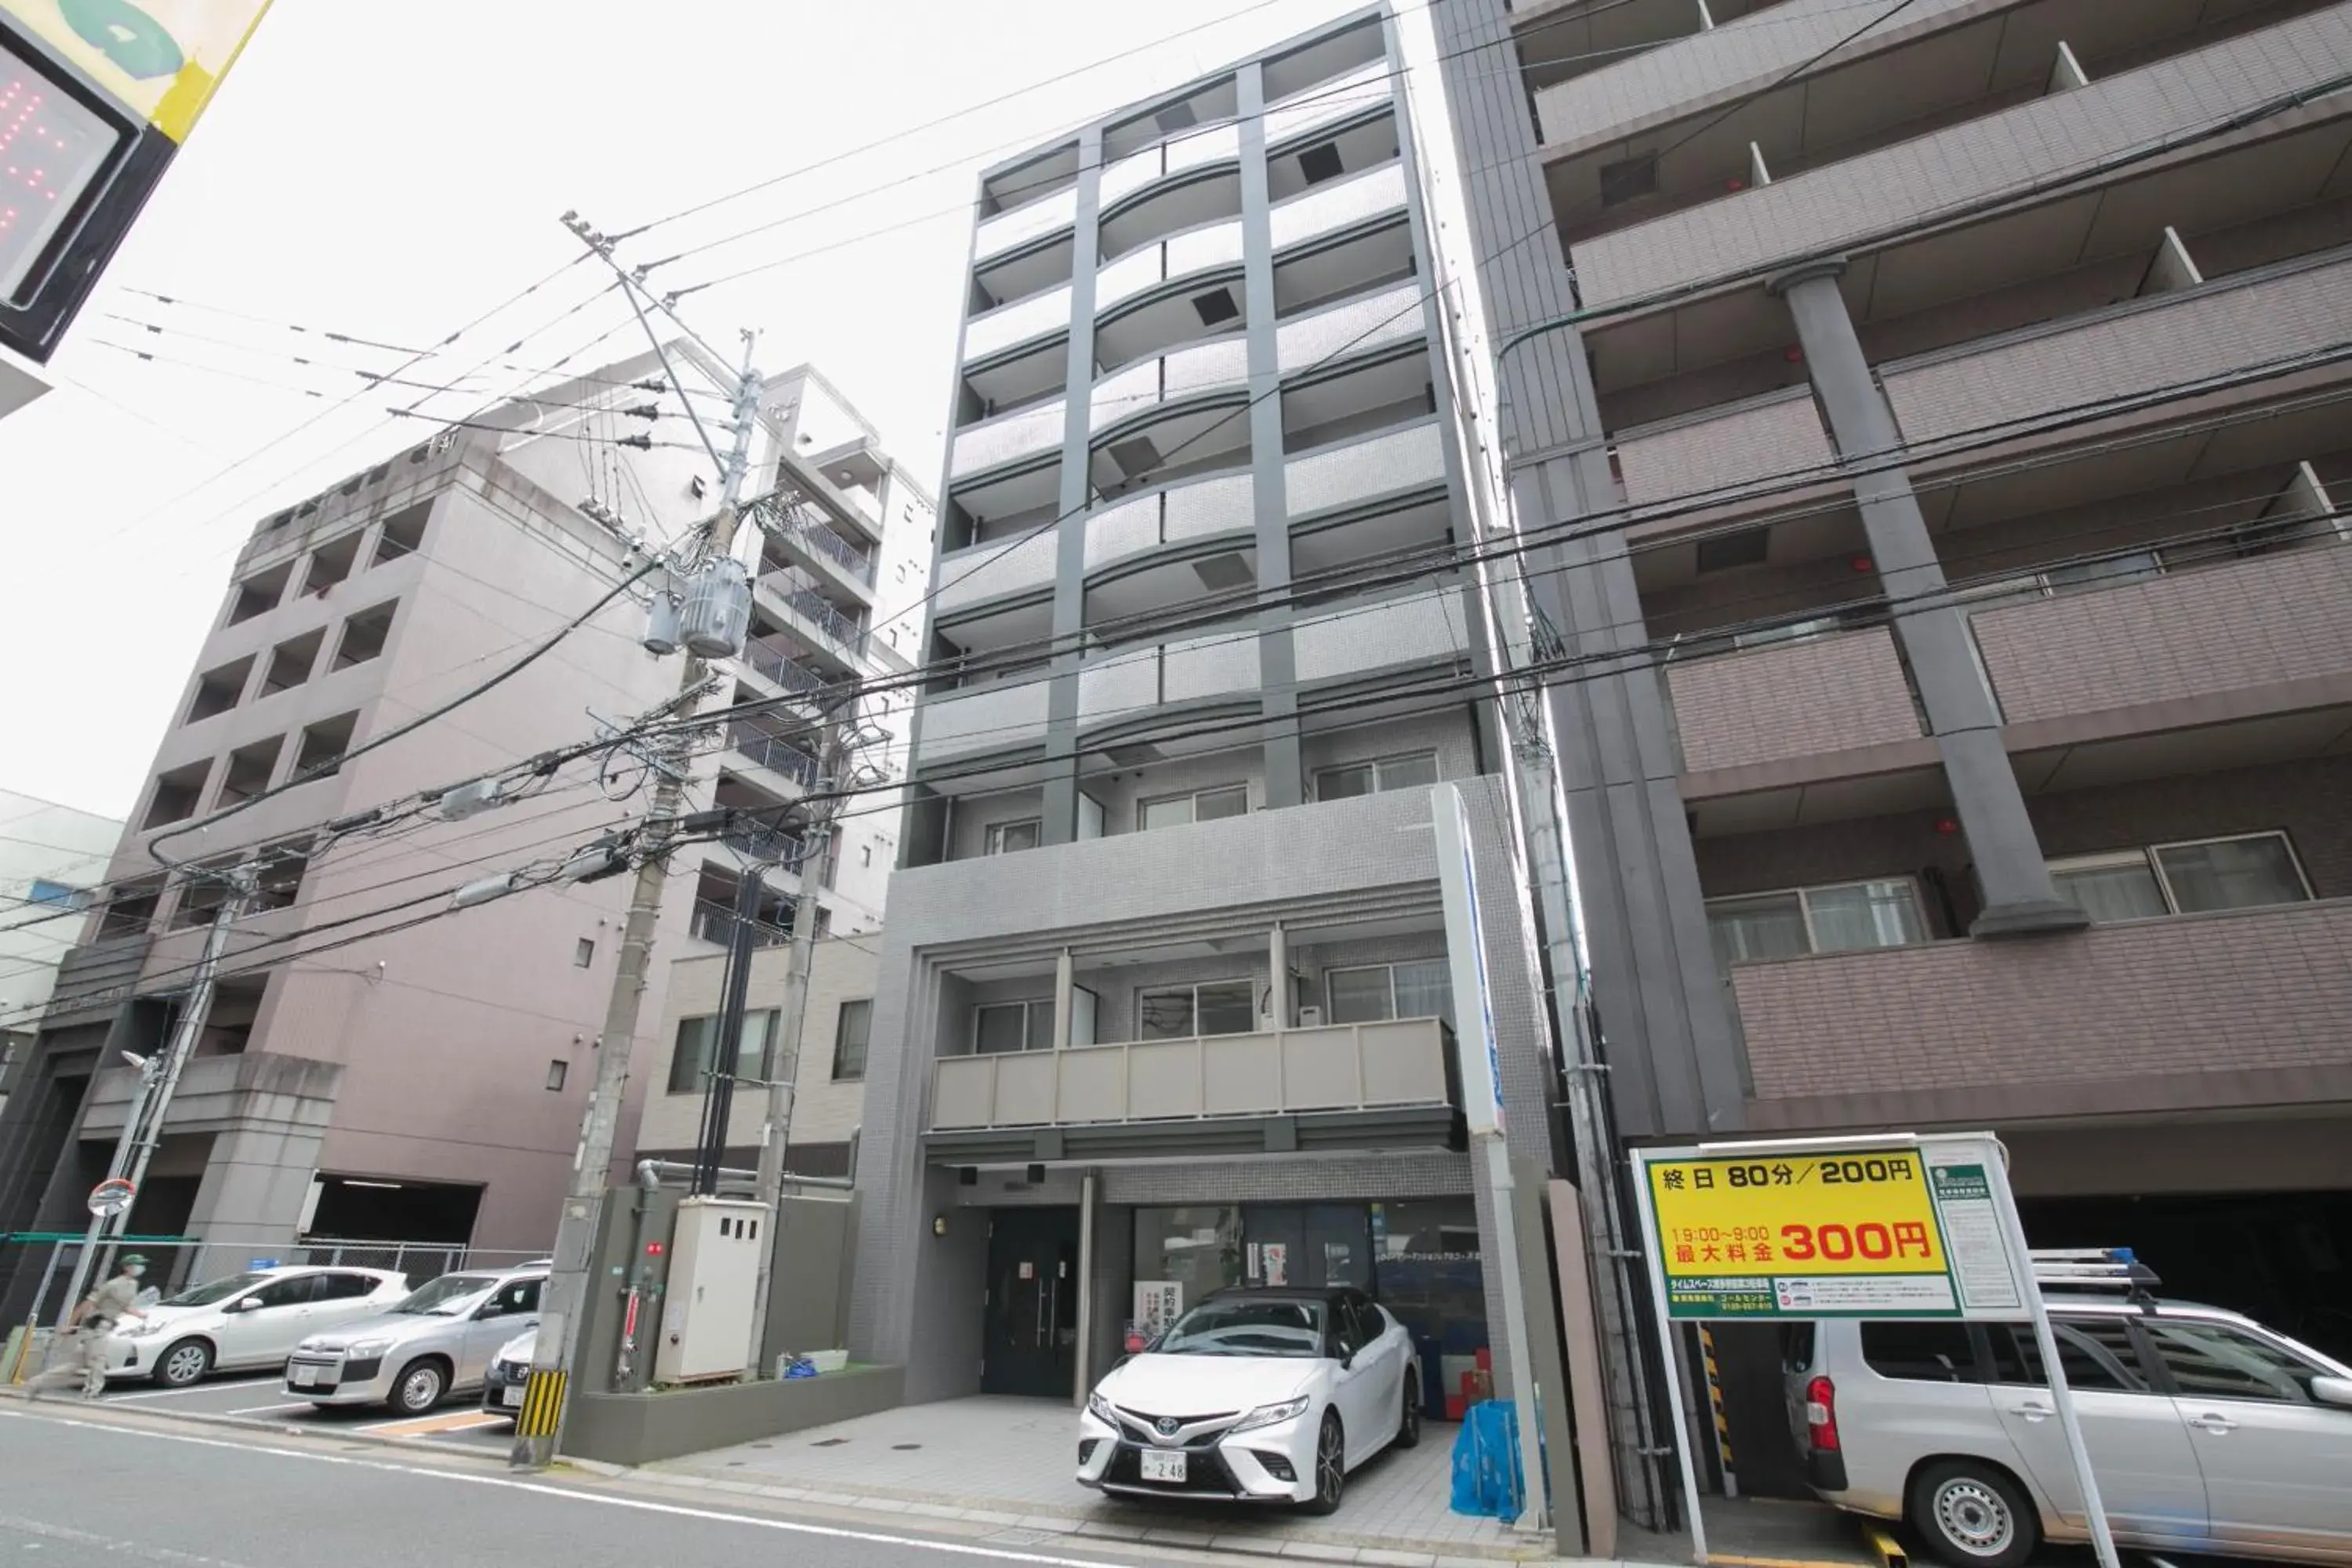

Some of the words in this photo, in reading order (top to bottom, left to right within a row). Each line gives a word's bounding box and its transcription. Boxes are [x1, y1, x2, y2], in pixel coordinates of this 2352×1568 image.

[1663, 1168, 1715, 1190] 終日
[1676, 1243, 1774, 1263] 最大料金
[1781, 1221, 1932, 1261] 300円
